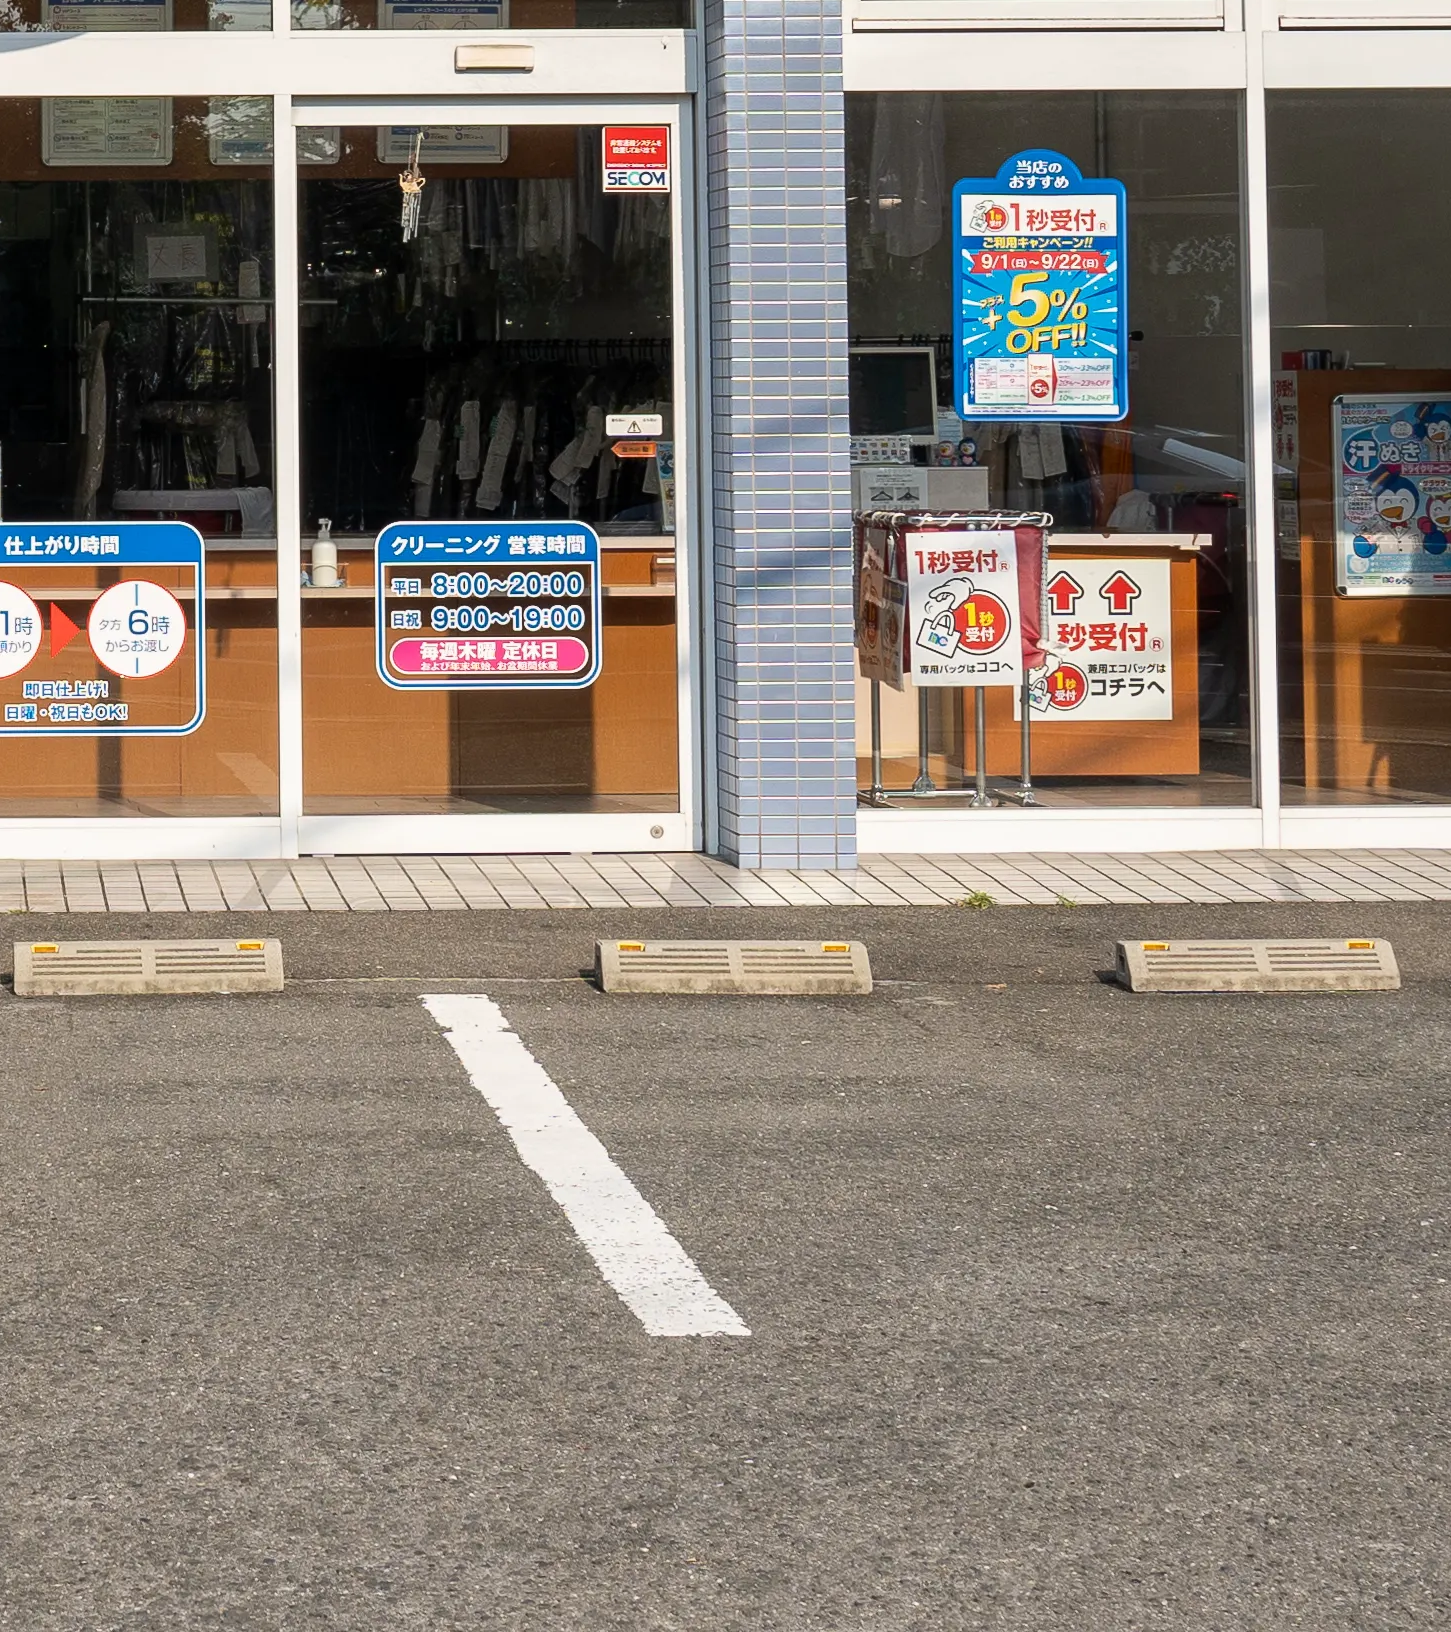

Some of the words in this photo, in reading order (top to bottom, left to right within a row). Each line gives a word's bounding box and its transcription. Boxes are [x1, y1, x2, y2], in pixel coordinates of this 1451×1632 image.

[1016, 160, 1063, 175] 当店の
[607, 171, 666, 186] SECOM
[1008, 176, 1070, 190] おすすめ
[1009, 202, 1097, 232] 1秒受付
[1006, 271, 1089, 328] 5%
[1006, 322, 1089, 355] OFF!!
[1349, 439, 1422, 469] 汗ぬき
[4, 535, 119, 556] 仕上がり時間
[391, 534, 501, 556] クリーニング
[507, 534, 586, 556] 営業時間
[914, 549, 998, 576] 1秒受付
[391, 578, 421, 596] 平日
[98, 618, 121, 631] 夕方
[128, 609, 170, 635] 6時
[391, 610, 422, 630] 日祝
[963, 601, 995, 627] 1秒
[965, 628, 996, 643] 受付
[1057, 621, 1149, 652] 秒受付
[105, 639, 169, 653] からお渡し
[419, 641, 497, 661] 毎週木曜
[502, 641, 558, 661] 定休日
[23, 680, 109, 699] 即日仕上げ!
[1054, 670, 1077, 690] 1秒
[1090, 678, 1166, 697] コチラへ
[1054, 690, 1077, 702] 受付
